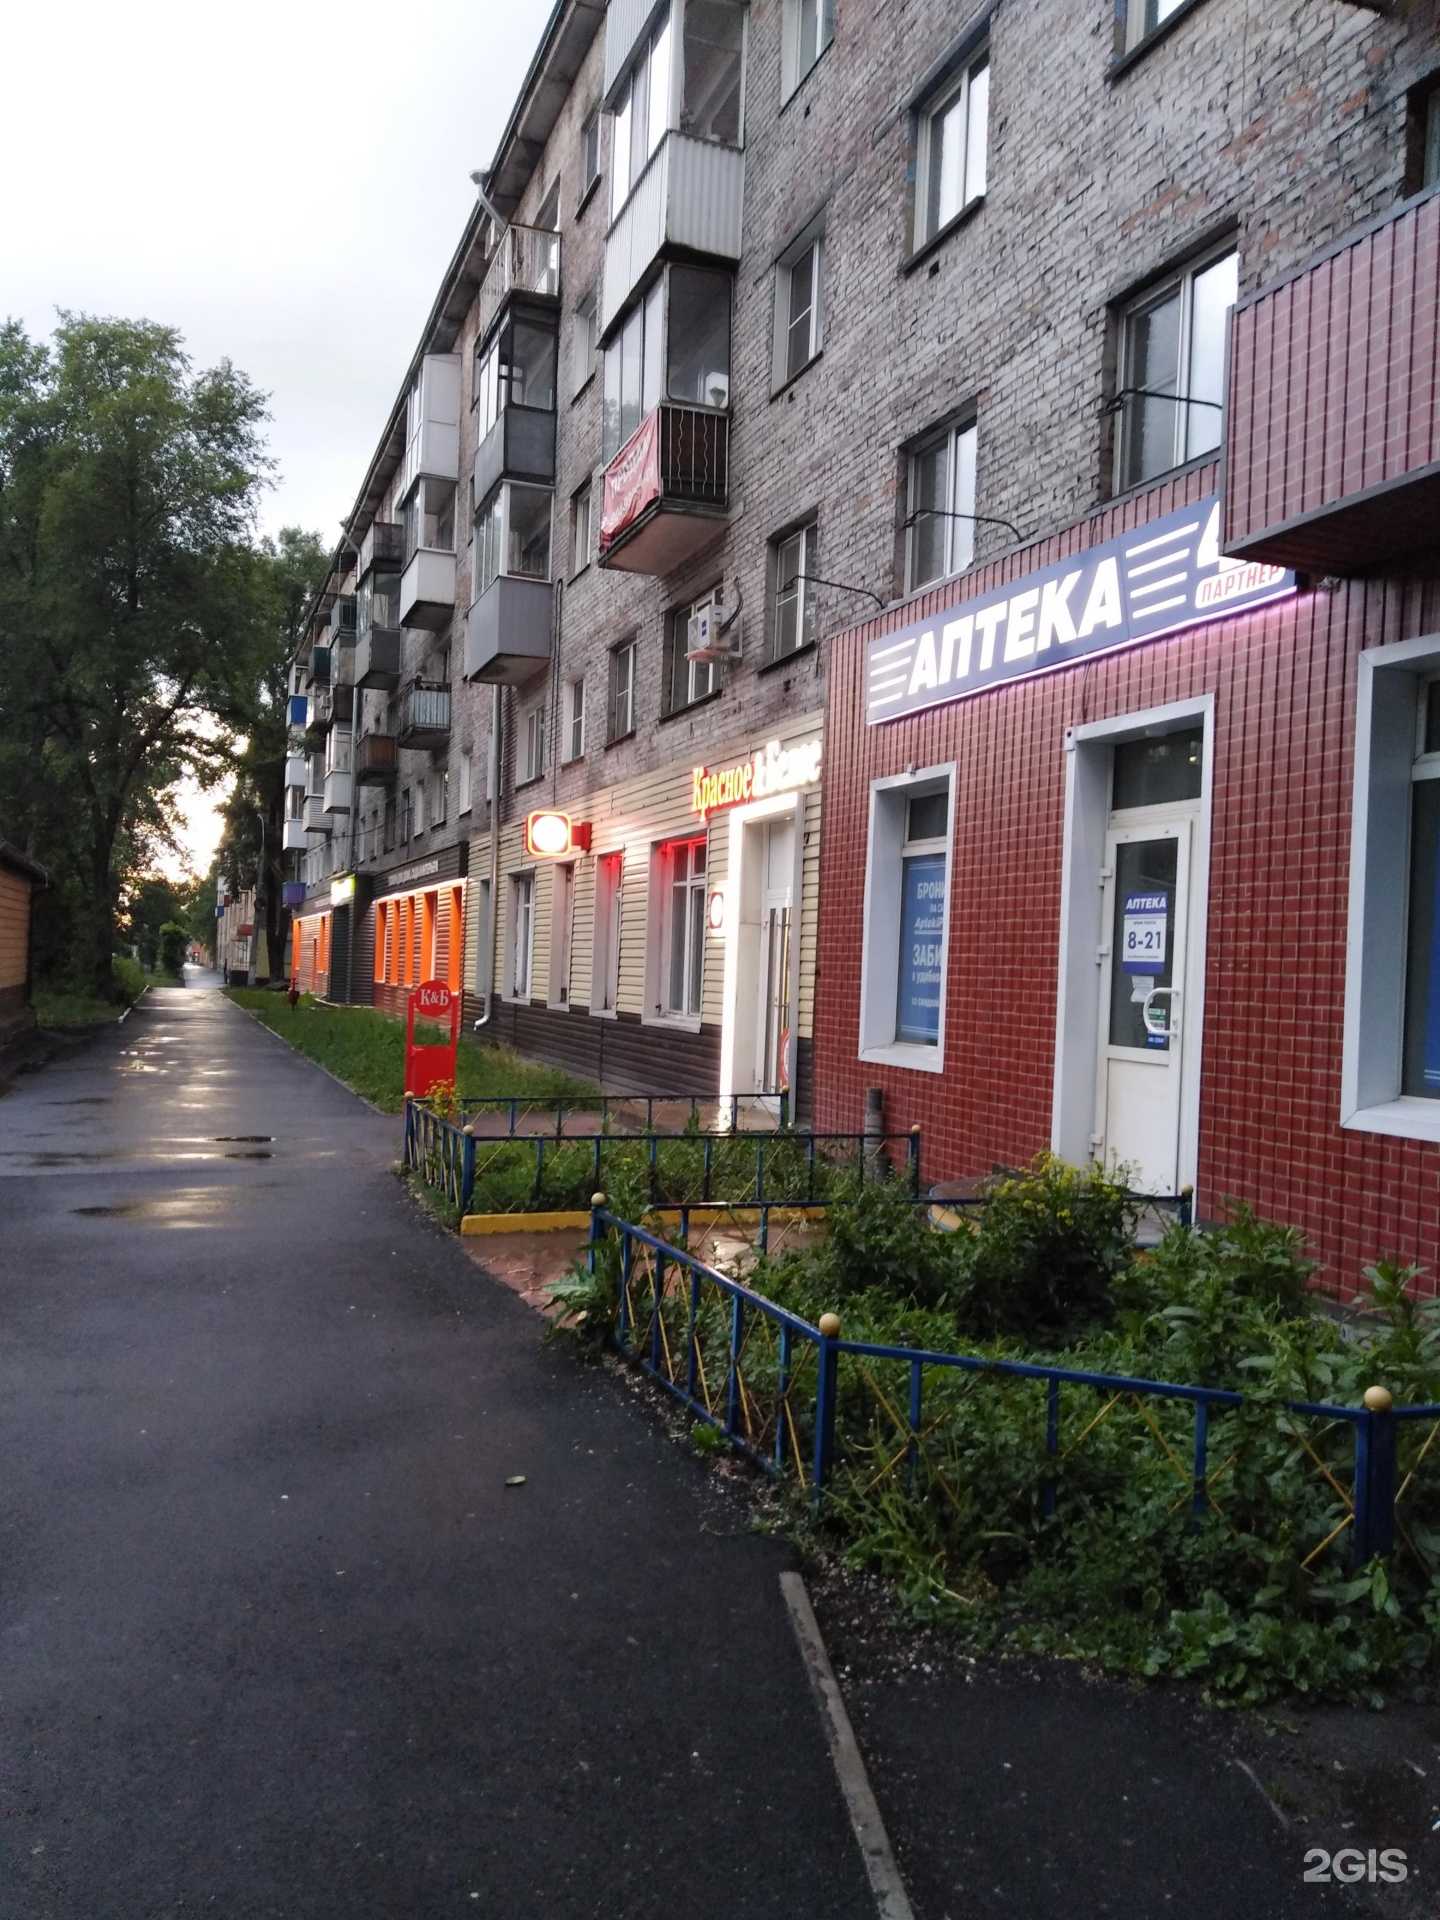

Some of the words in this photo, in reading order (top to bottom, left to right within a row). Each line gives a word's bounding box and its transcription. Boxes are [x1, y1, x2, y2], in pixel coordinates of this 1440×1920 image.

[908, 557, 1122, 694] АПТЕКА
[692, 765, 752, 822] Красное
[1126, 896, 1167, 910] АПТЕКА
[1128, 931, 1161, 949] 8-21
[420, 989, 449, 1007] К&Б
